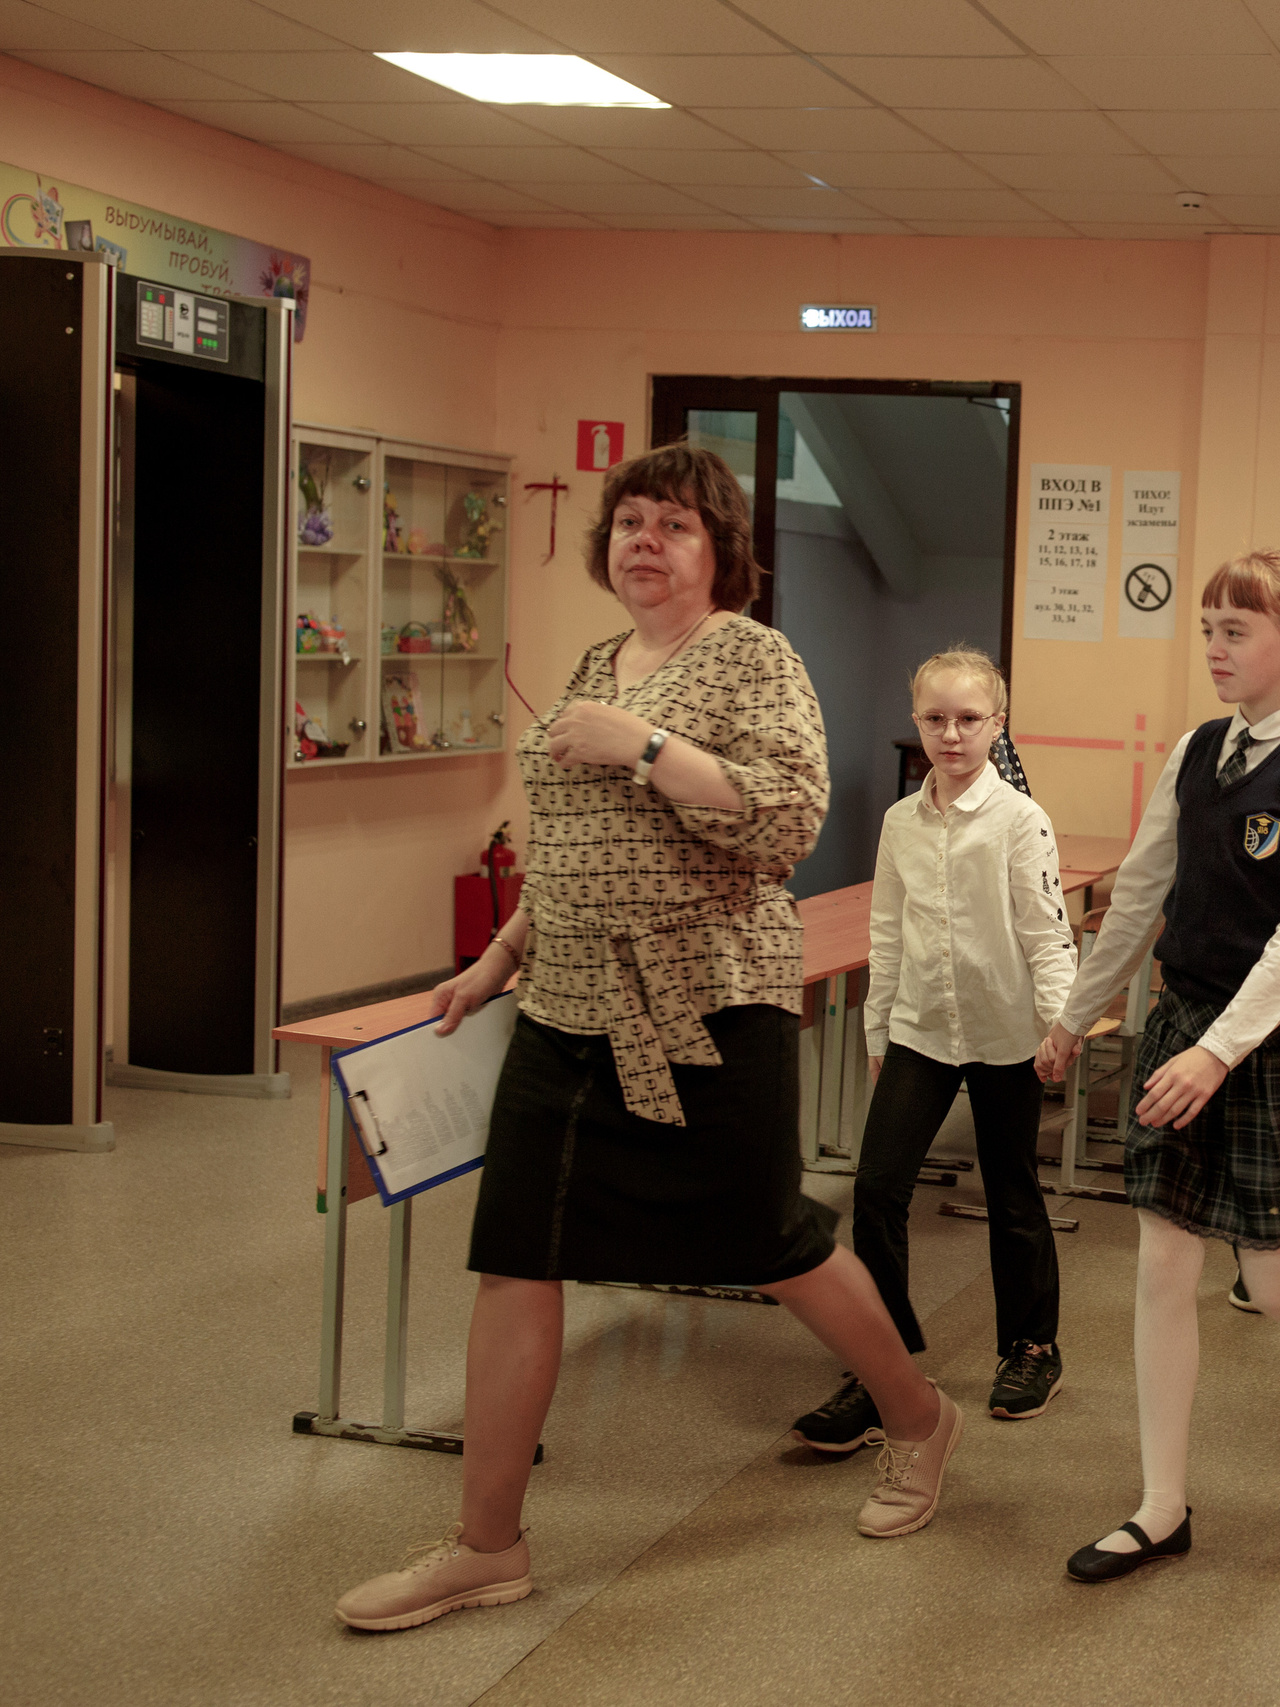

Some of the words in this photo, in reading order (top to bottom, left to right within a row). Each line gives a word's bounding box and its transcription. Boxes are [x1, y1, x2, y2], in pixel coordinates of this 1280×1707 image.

[105, 206, 213, 254] ВЫДУМЫВАЙ,
[169, 251, 234, 285] ПРОБУЙ,
[1041, 478, 1086, 493] ВХОД
[1091, 480, 1101, 492] В
[1133, 490, 1171, 500] ТИХО!
[1039, 498, 1073, 511] ППЭ
[1077, 499, 1100, 512] №1
[1139, 504, 1164, 515] Идут
[1048, 529, 1055, 540] 2
[1059, 532, 1090, 541] этаж
[1038, 545, 1051, 554] 11,
[1054, 545, 1067, 554] 12,
[1070, 546, 1083, 555] 13,
[1085, 546, 1098, 556] 14,
[1040, 557, 1052, 566] 15,
[1055, 558, 1068, 567] 16,
[1071, 558, 1083, 568] 17,
[1086, 559, 1096, 568] 18
